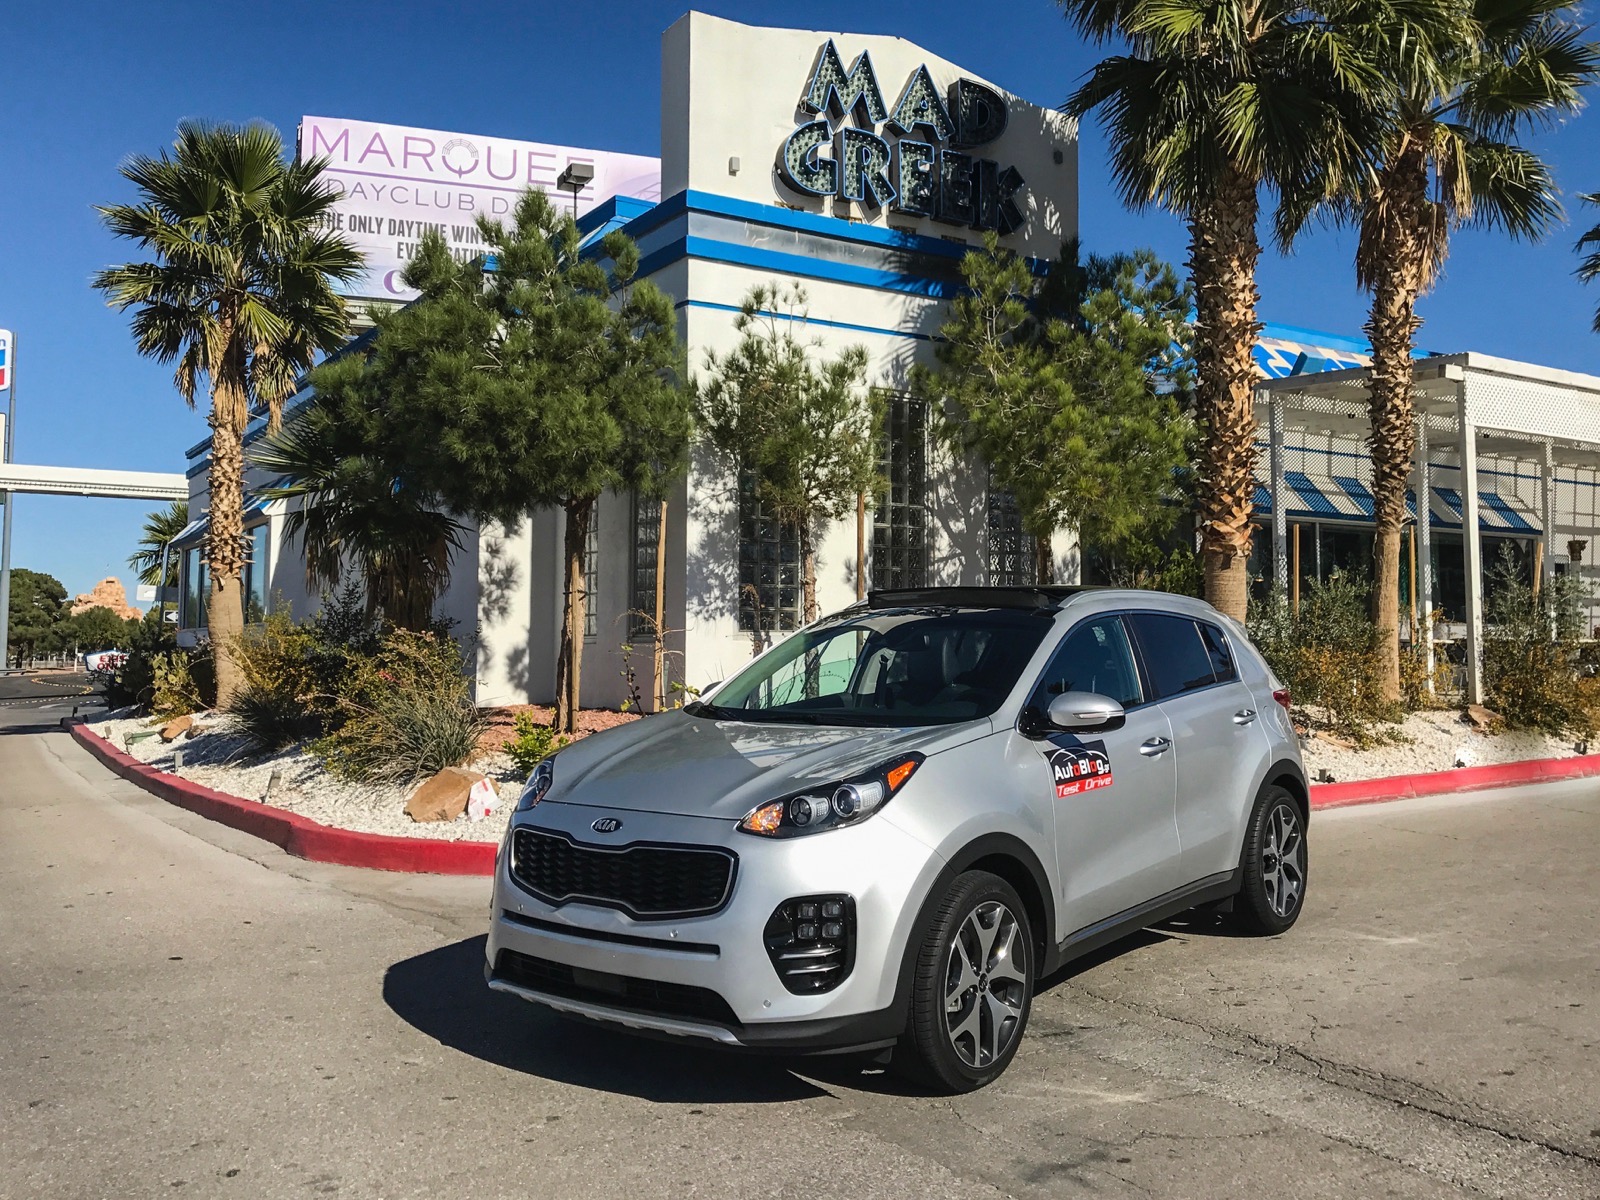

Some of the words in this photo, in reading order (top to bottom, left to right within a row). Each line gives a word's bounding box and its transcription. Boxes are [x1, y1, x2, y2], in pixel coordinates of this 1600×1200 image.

[796, 37, 1008, 148] MAD
[776, 118, 1026, 235] GREEK
[327, 178, 475, 212] DAYCLUB
[320, 211, 344, 231] HE
[348, 214, 384, 235] ONLY
[1056, 784, 1080, 797] Test
[1085, 776, 1112, 790] Drive
[594, 819, 617, 831] KIA
